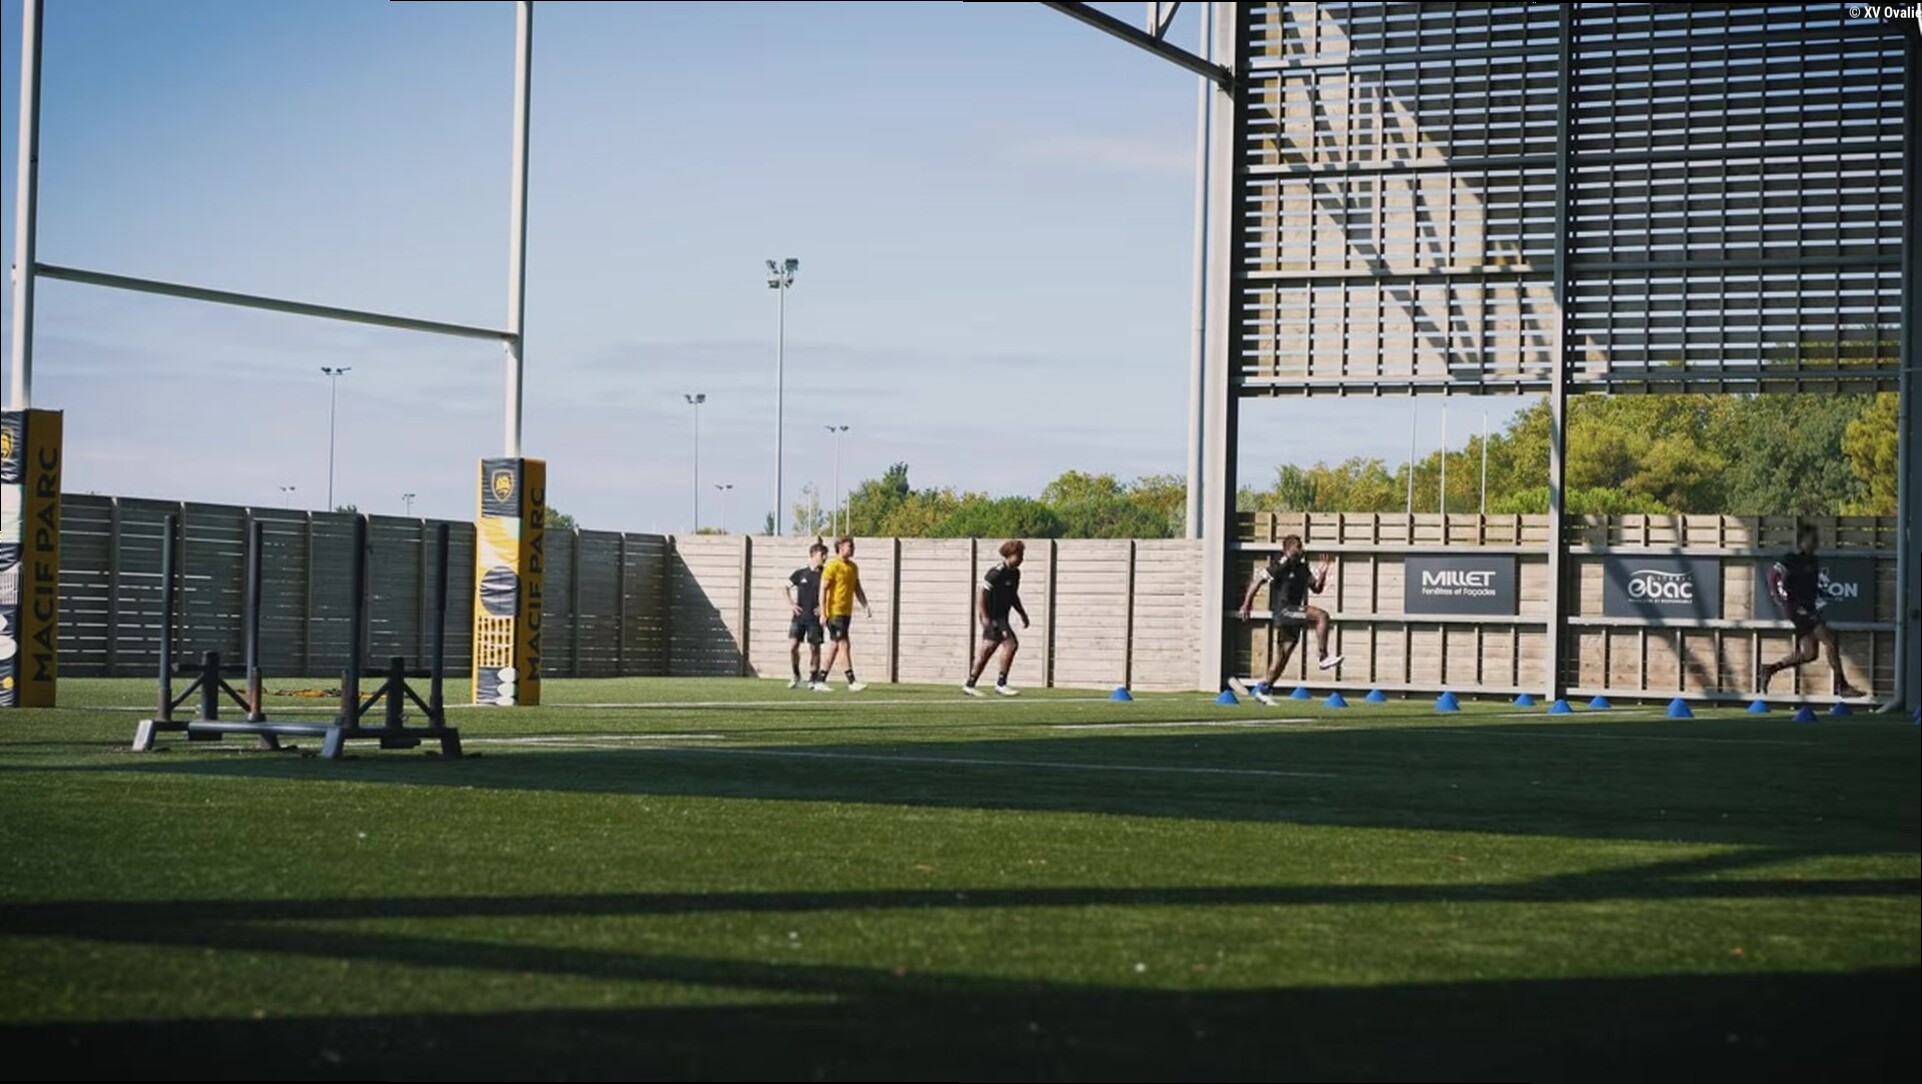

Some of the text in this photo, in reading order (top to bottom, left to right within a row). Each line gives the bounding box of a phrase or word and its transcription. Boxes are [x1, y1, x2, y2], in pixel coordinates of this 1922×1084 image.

[33, 448, 58, 681] MACIF PARC
[527, 488, 545, 681] MACIF PARC
[1422, 570, 1497, 587] MILLET
[1628, 575, 1693, 599] ebac
